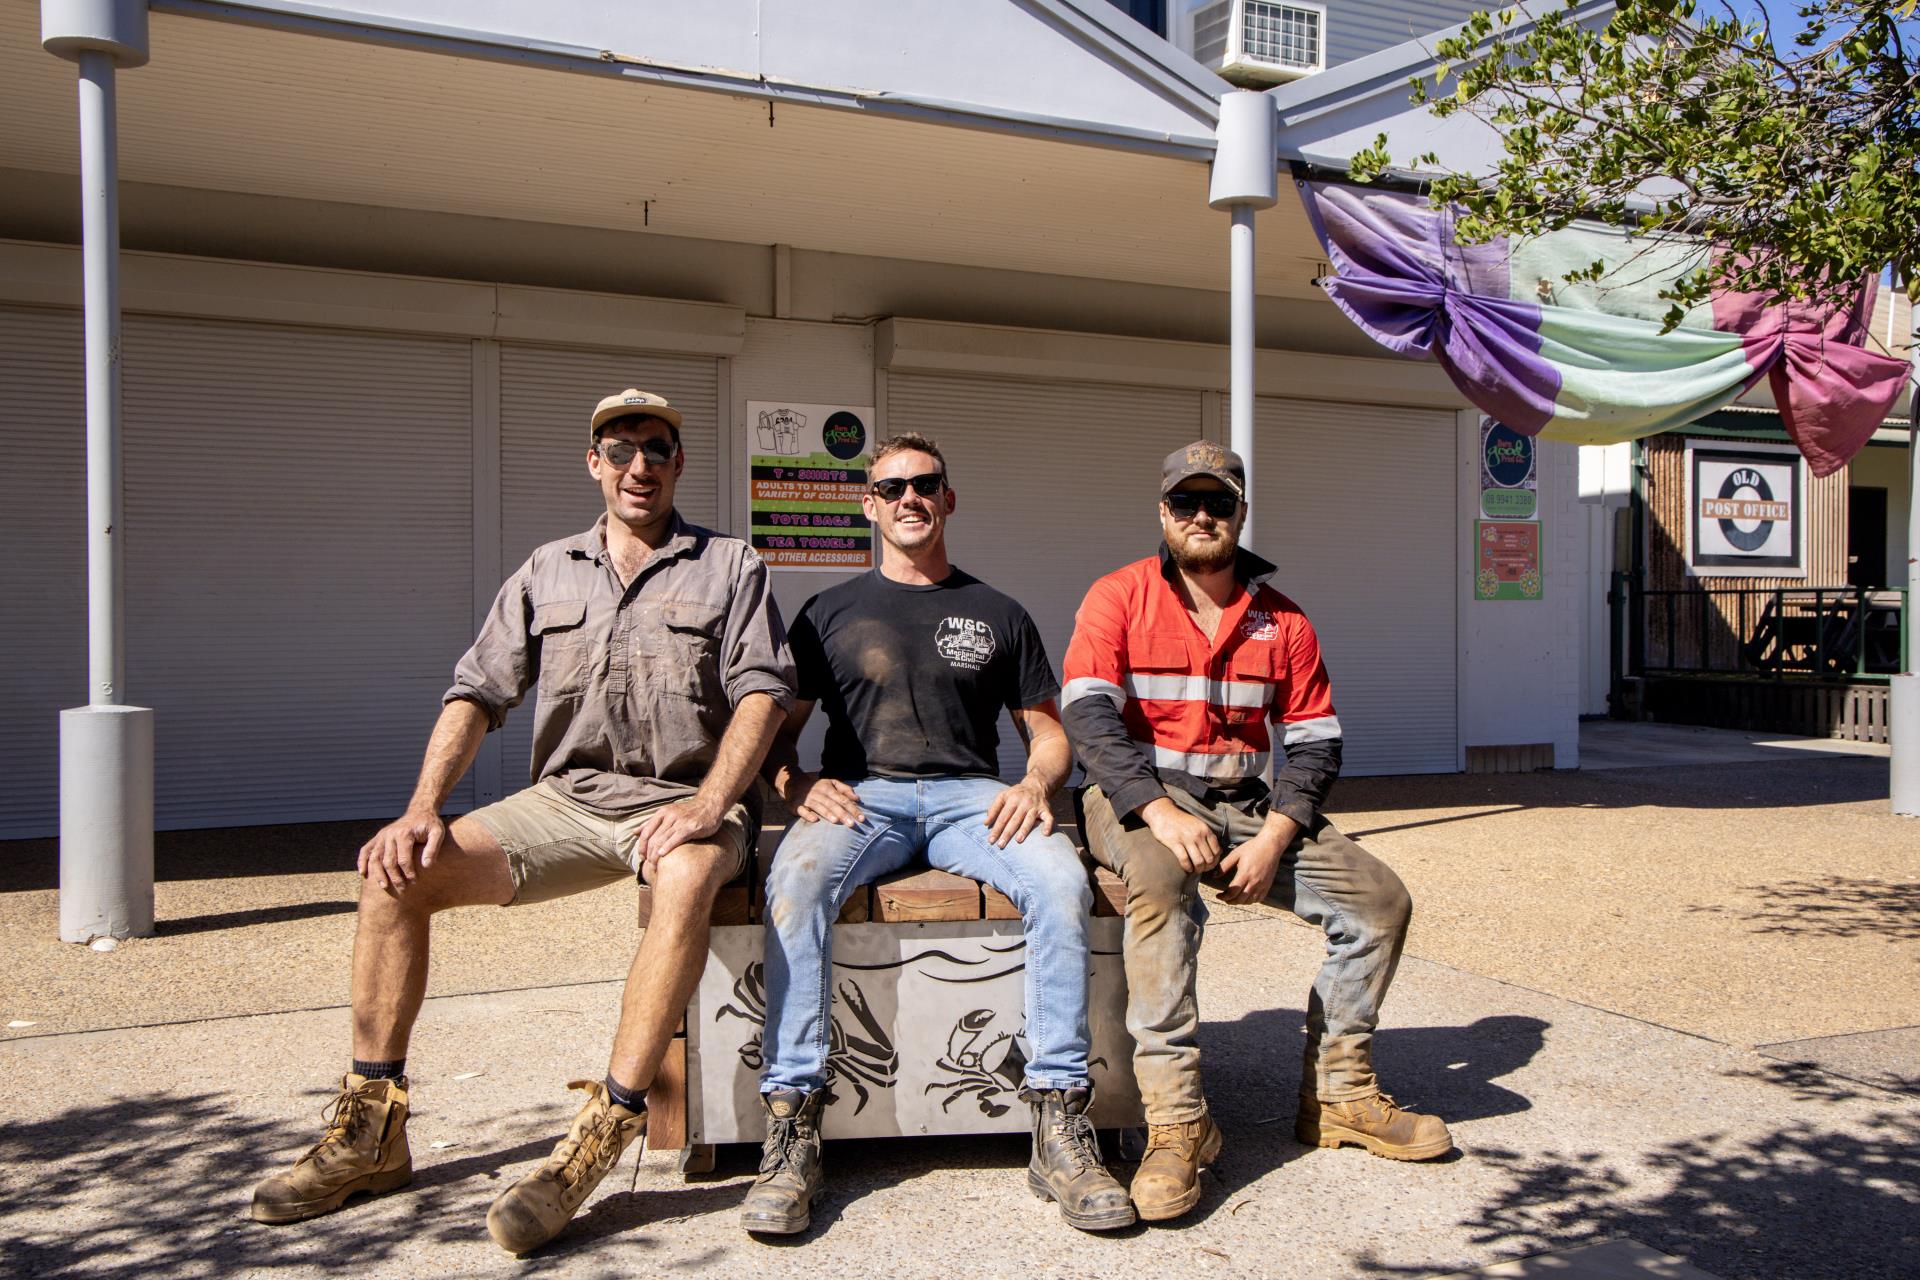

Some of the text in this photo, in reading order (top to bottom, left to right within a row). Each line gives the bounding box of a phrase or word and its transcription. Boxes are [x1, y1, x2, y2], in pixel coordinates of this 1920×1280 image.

[824, 425, 865, 446] good
[1487, 439, 1531, 468] good
[798, 469, 847, 481] SHIRTS
[1732, 470, 1760, 487] OLD
[756, 481, 867, 493] ADULTS TO KIDS SIZES
[758, 490, 865, 501] VARIETY OF COLOURS
[1706, 501, 1787, 518] POST OFFICE
[770, 513, 852, 527] TOTE BAGS
[766, 536, 856, 549] TEA TOWELS
[760, 551, 866, 564] AND OTHER ACCESSORIES
[947, 616, 986, 633] W&C
[946, 648, 985, 661] Mechanical
[950, 661, 980, 670] MARSHALL
